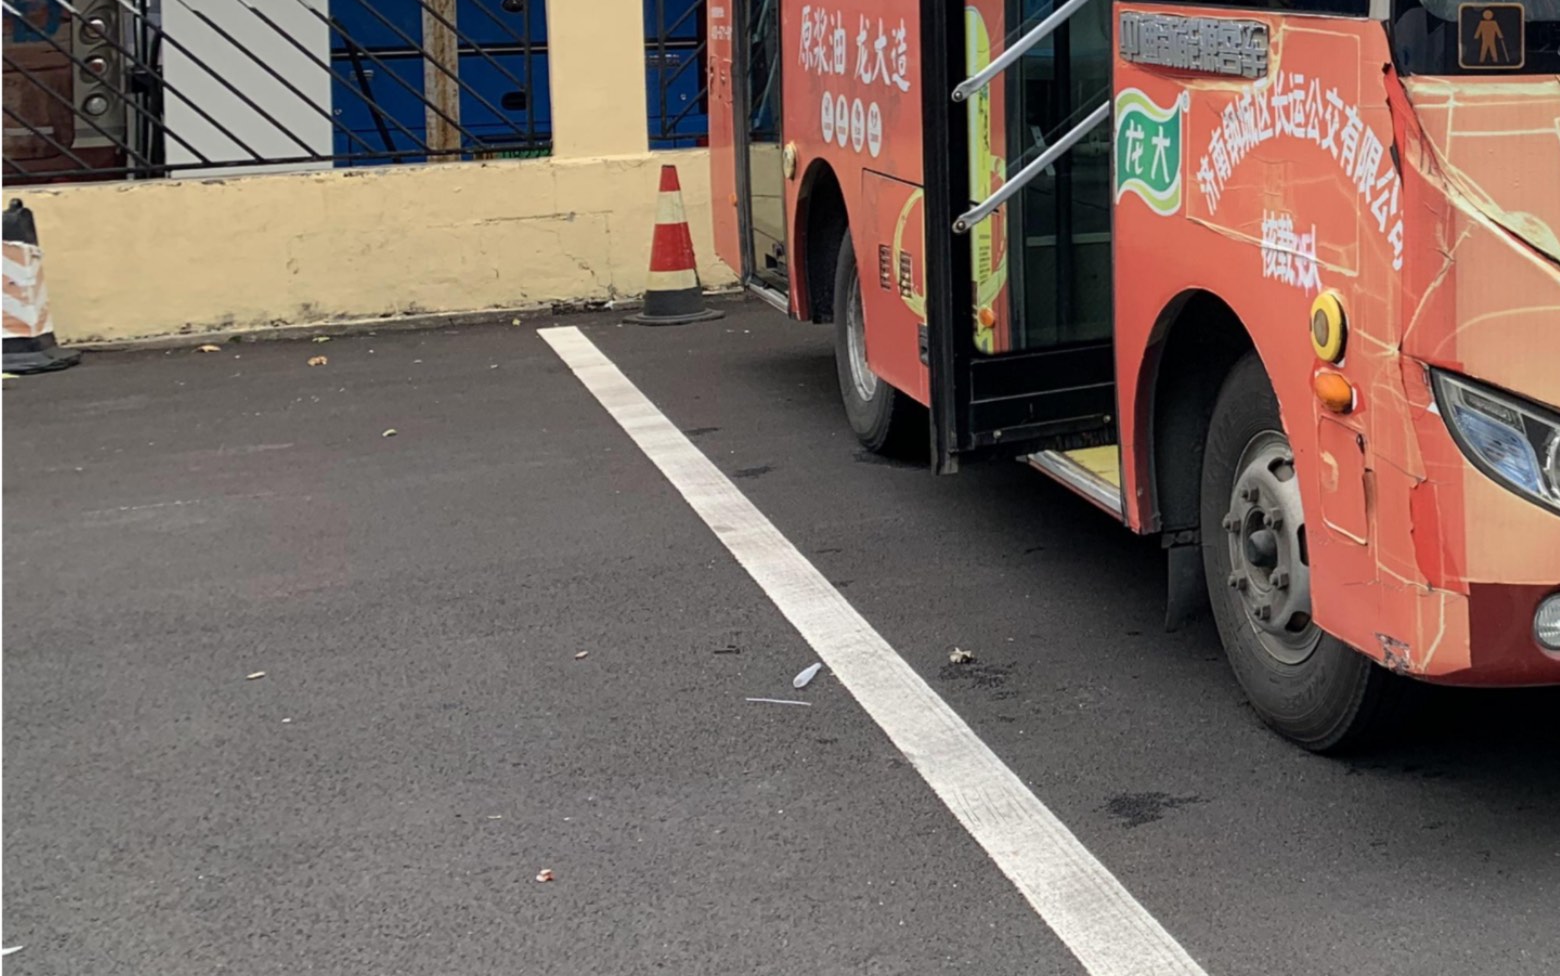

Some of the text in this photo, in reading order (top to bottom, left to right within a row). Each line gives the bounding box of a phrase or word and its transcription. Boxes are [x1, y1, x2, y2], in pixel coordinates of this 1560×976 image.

[798, 4, 847, 76] 原浆油
[854, 13, 911, 93] 龙大造
[1124, 118, 1171, 184] 龙大
